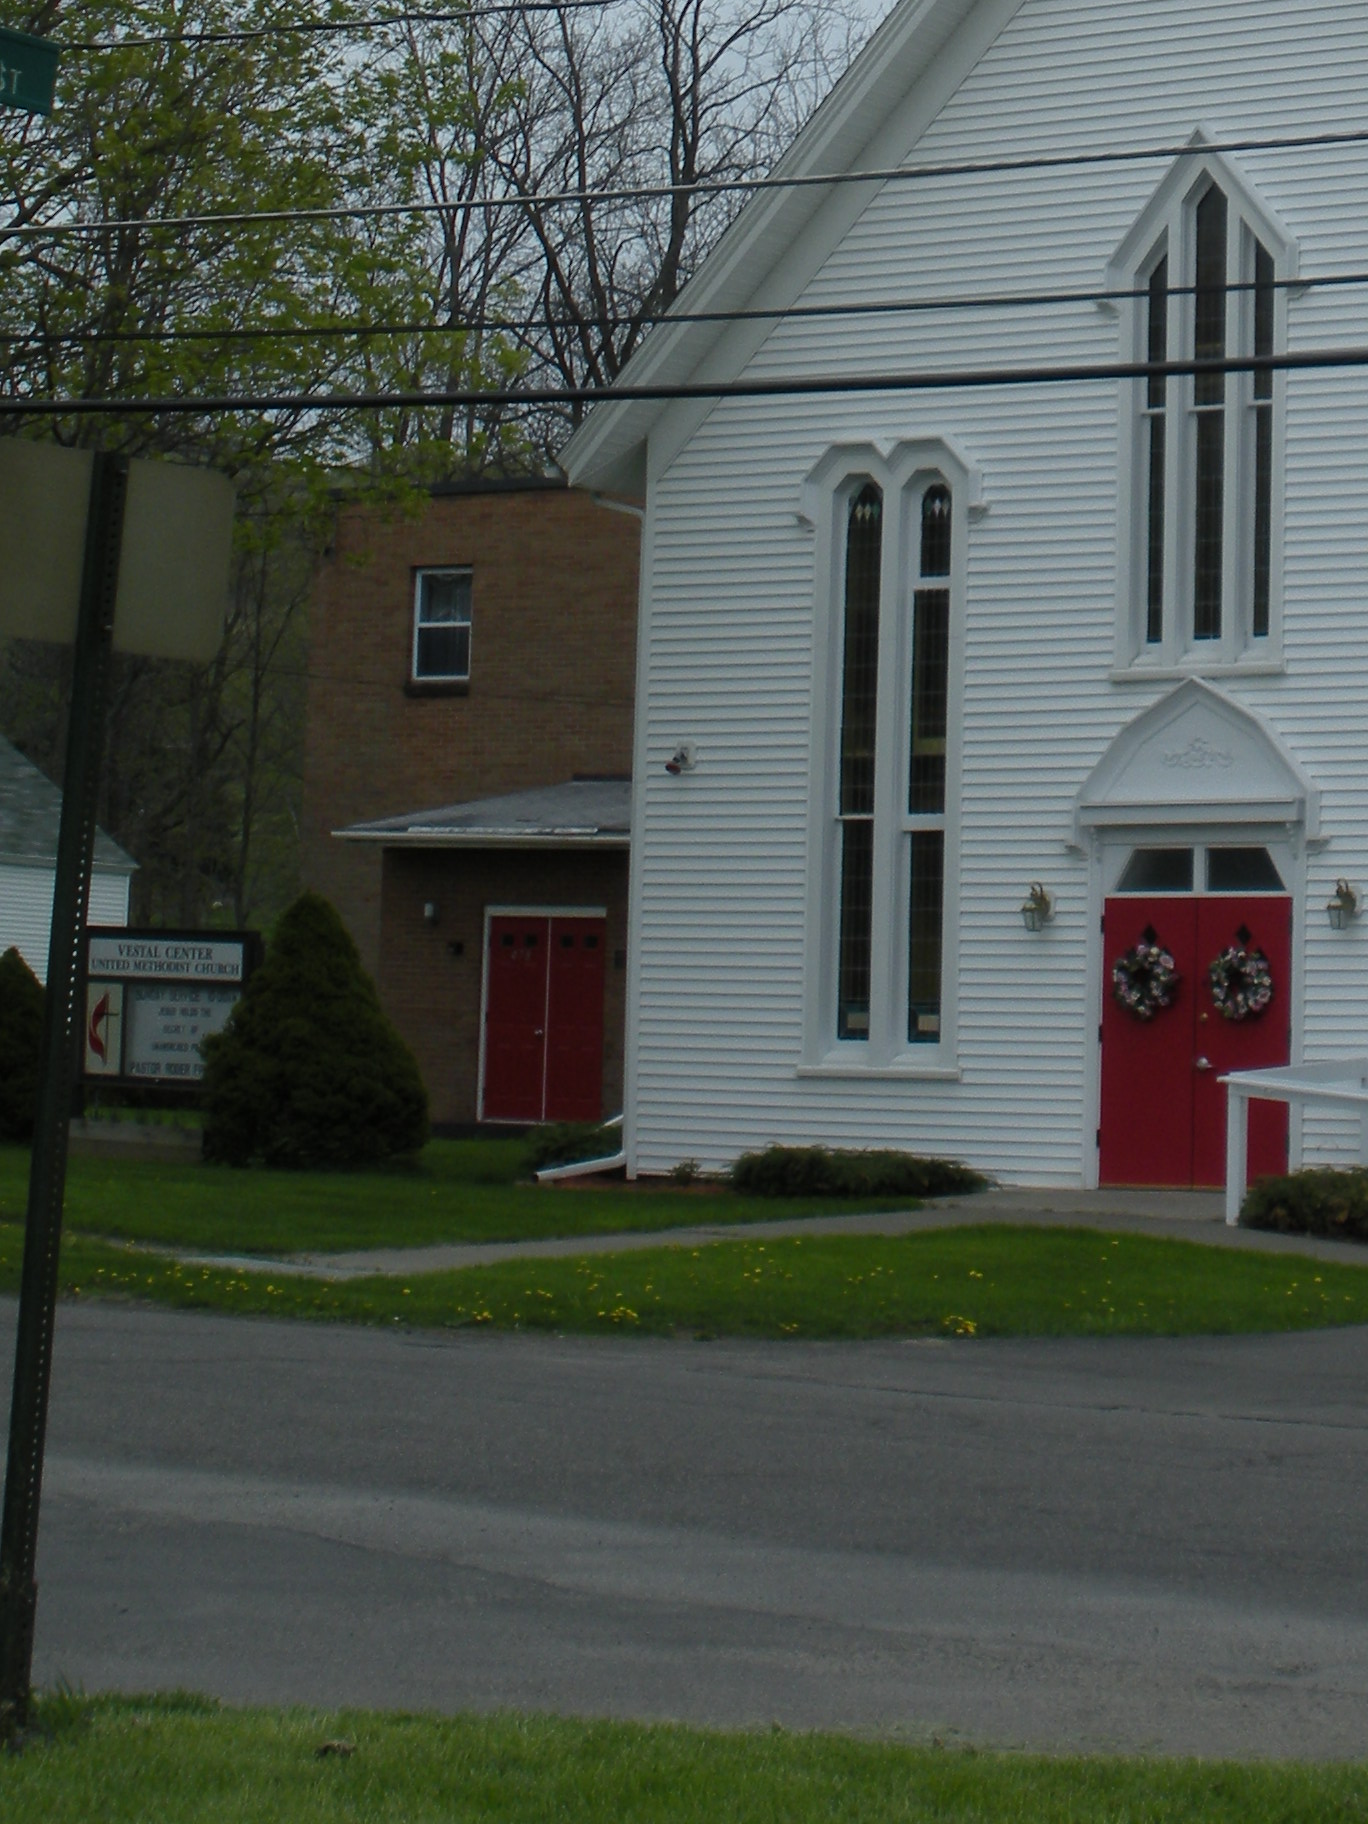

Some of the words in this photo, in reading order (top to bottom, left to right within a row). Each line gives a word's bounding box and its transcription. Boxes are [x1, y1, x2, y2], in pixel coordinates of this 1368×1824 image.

[118, 944, 161, 958] VESTAL
[165, 946, 213, 961] CENTER
[91, 958, 130, 971] UNITED
[133, 960, 190, 974] METHODIST
[194, 962, 239, 975] CHURCH
